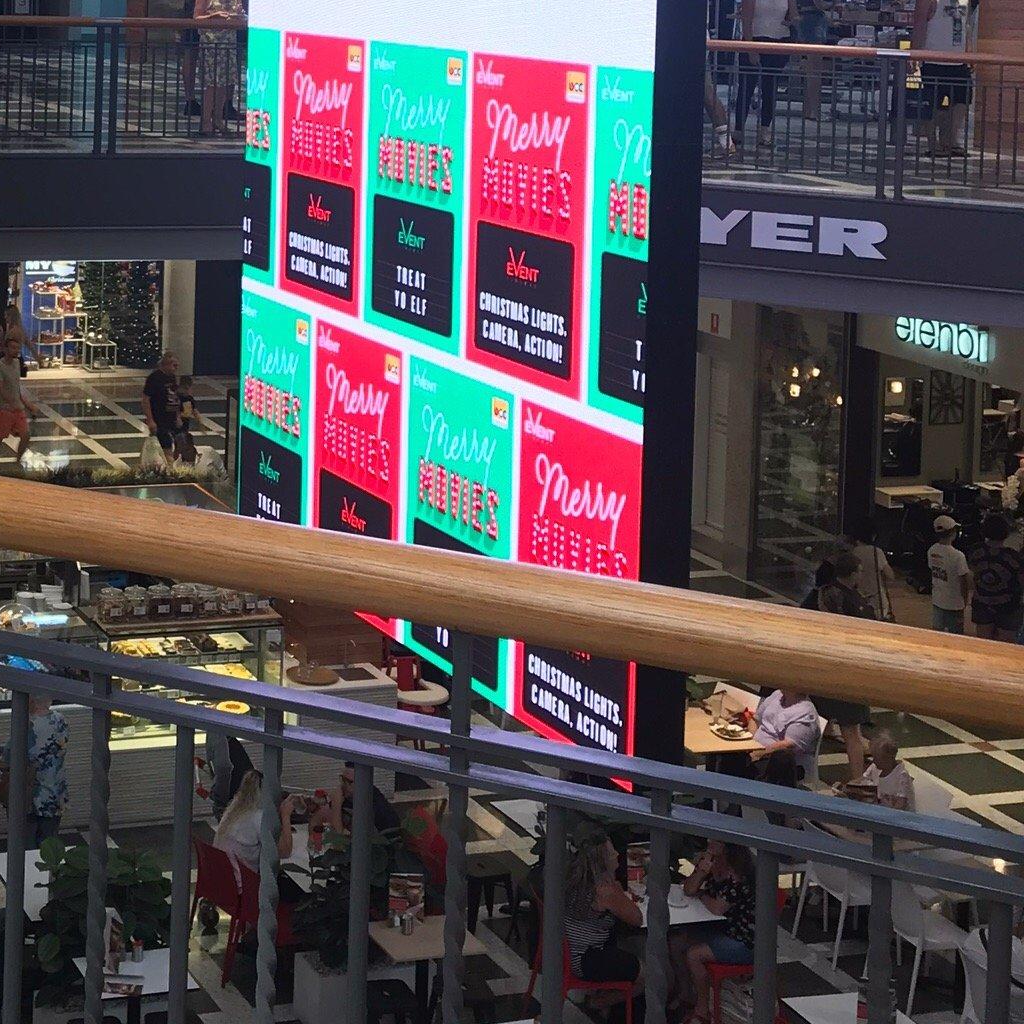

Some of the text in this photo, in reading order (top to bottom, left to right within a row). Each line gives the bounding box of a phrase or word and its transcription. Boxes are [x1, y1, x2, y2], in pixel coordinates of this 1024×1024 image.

[293, 70, 353, 129] Merry
[382, 84, 451, 150] Merry
[291, 118, 353, 167] MOVIES
[379, 135, 453, 194] MOVIES
[486, 99, 571, 173] Merry
[482, 156, 572, 219] MOVIES
[289, 231, 325, 257] CHRISTMAS
[291, 254, 348, 288] CAMERA, ACTION!
[394, 289, 427, 316] YO ELF
[396, 266, 426, 290] TREAT
[479, 292, 529, 325] CHRISTMAS
[246, 328, 300, 397] Merry
[483, 320, 564, 364] CAMERA, ACTION!
[244, 374, 301, 438] MOVIES
[326, 363, 390, 440] Merry
[324, 412, 391, 481] MOVIES
[422, 405, 497, 491] Merry
[257, 492, 281, 520] TREAT
[418, 456, 500, 541] MOVIES
[535, 453, 627, 551] Merry
[436, 626, 449, 648] YO
[528, 653, 582, 702] CHRISTMAS
[531, 684, 618, 753] CAMERA, ACTION!
